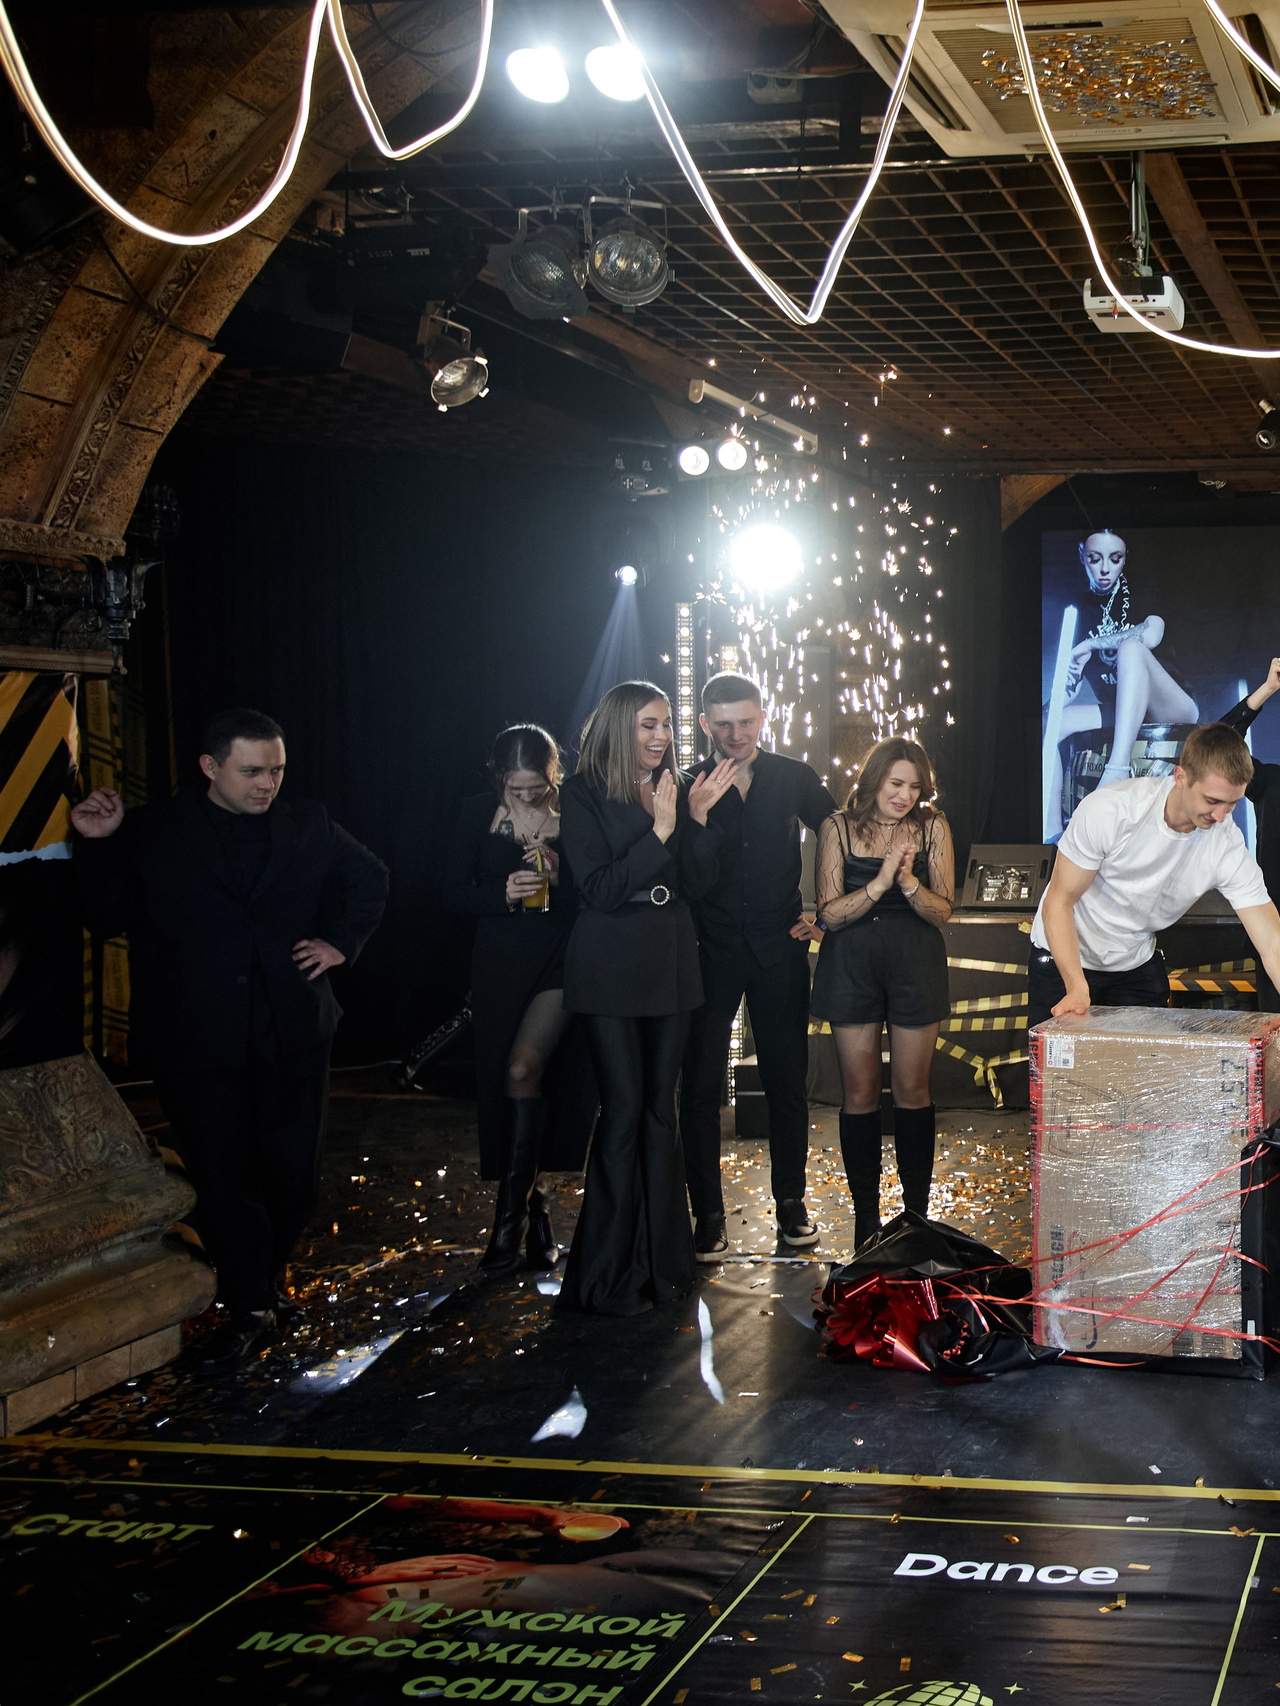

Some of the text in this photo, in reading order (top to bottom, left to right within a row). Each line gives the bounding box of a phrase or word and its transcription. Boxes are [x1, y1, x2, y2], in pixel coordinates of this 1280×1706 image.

[11, 1513, 215, 1543] Старт
[893, 1552, 1119, 1585] Dance
[367, 1600, 690, 1639] Мужской
[237, 1631, 658, 1672] массажный
[402, 1675, 625, 1706] салон
